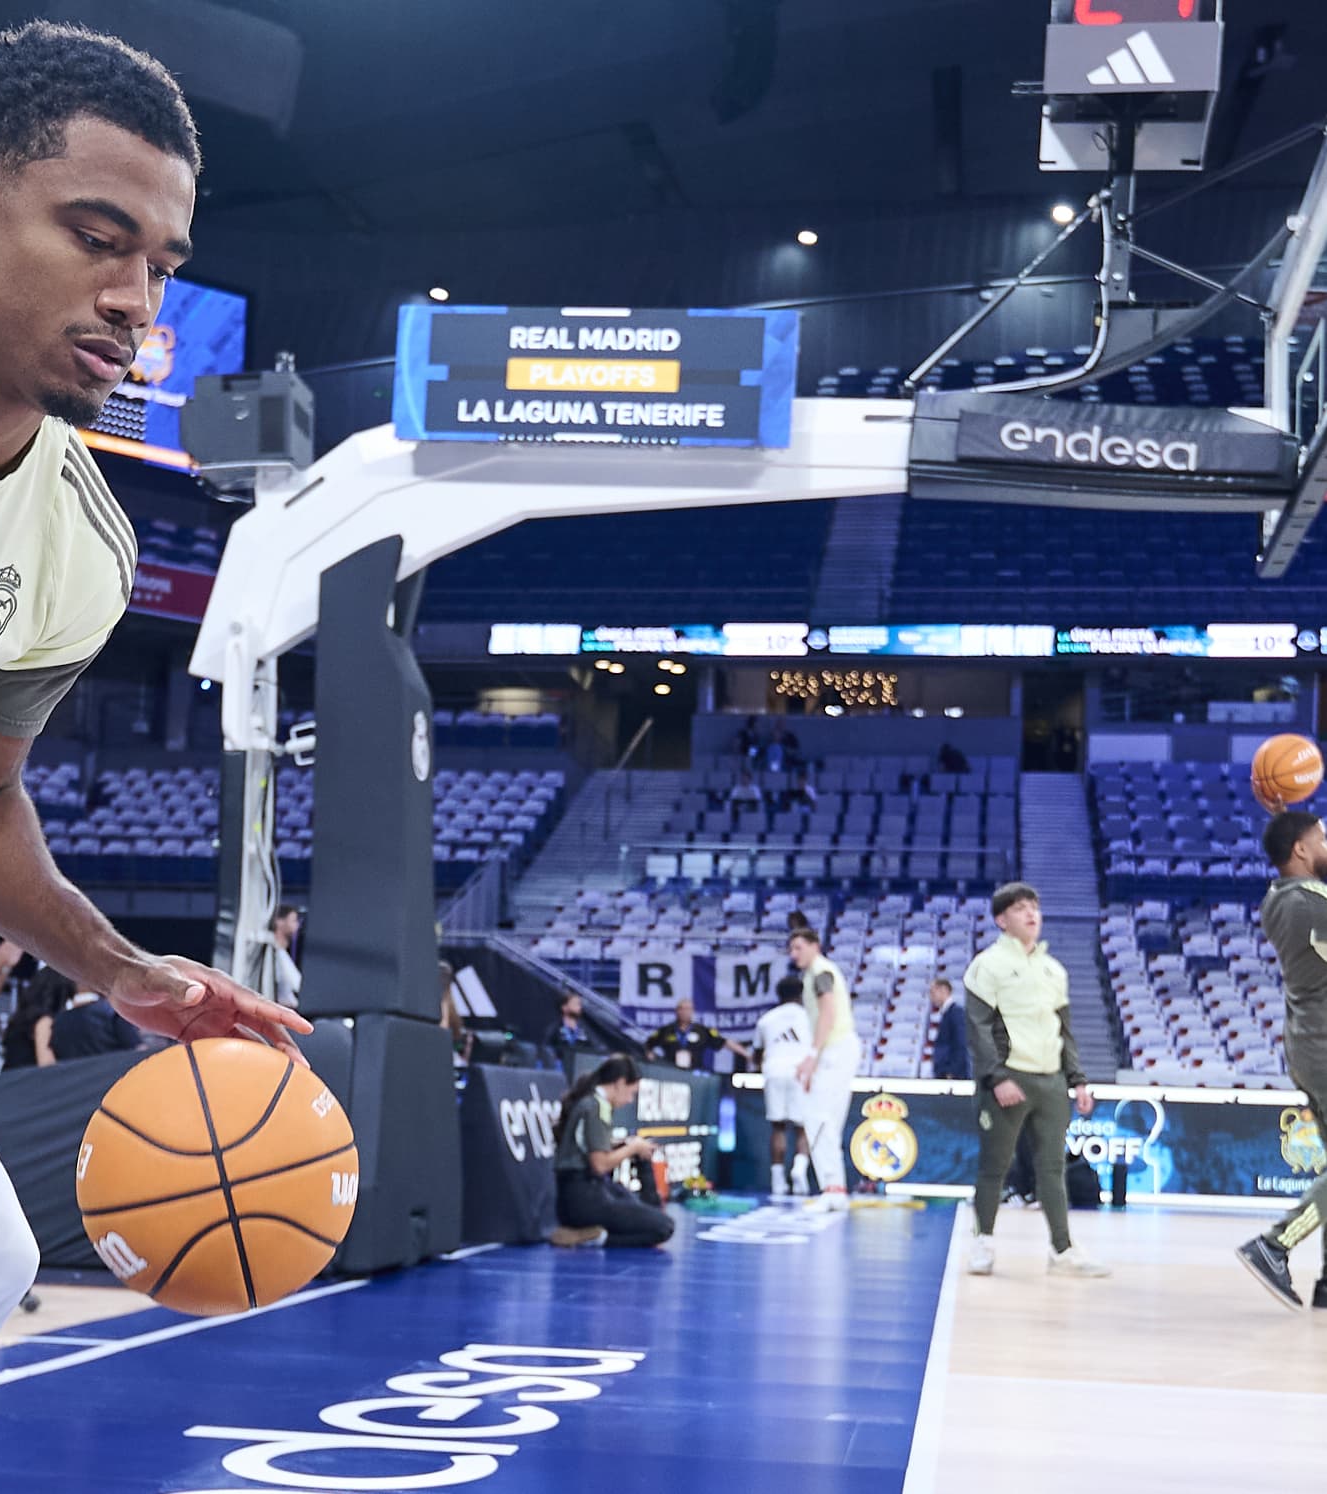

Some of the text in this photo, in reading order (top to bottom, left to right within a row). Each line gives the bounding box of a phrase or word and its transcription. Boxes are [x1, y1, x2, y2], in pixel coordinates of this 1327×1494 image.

[509, 327, 681, 352] REAL MADRID
[529, 364, 656, 387] PLAYOFFS
[457, 399, 725, 428] LA LAGUNA TENERIFE
[1000, 421, 1198, 472] endesa
[637, 962, 773, 999] R M
[174, 1343, 646, 1494] desa
